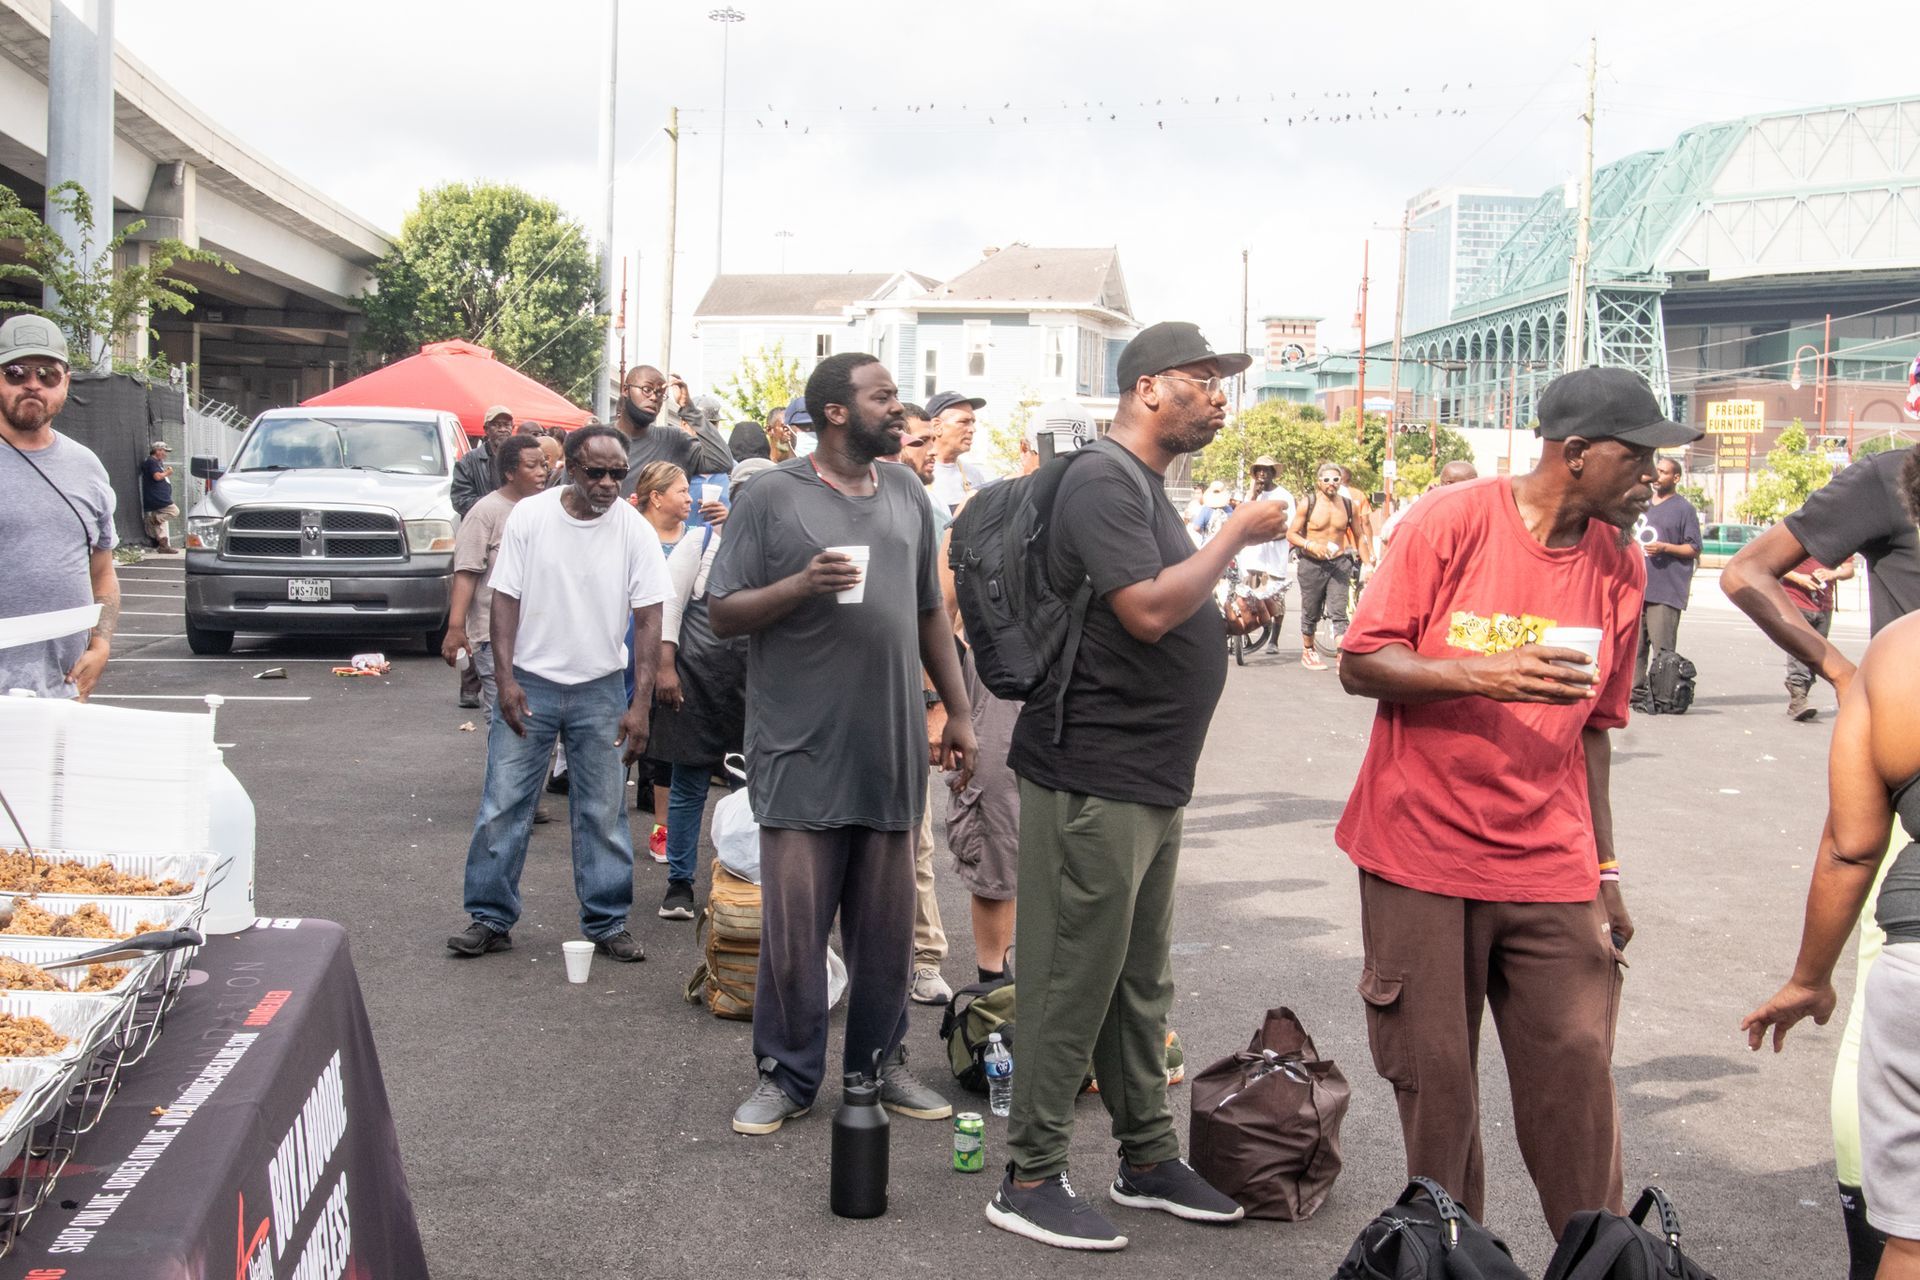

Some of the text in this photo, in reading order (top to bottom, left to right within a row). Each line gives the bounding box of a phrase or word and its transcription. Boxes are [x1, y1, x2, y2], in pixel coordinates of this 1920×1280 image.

[1708, 419, 1761, 430] FURNITURE
[1715, 404, 1755, 416] FREIGHT
[127, 1127, 182, 1159] ONLINE.
[268, 1049, 348, 1260] BUY A HOODIE
[101, 1160, 156, 1189] ORDER
[68, 1190, 131, 1226] ONLINE.
[48, 1227, 98, 1253] SHOP
[291, 1171, 351, 1280] MELESS
